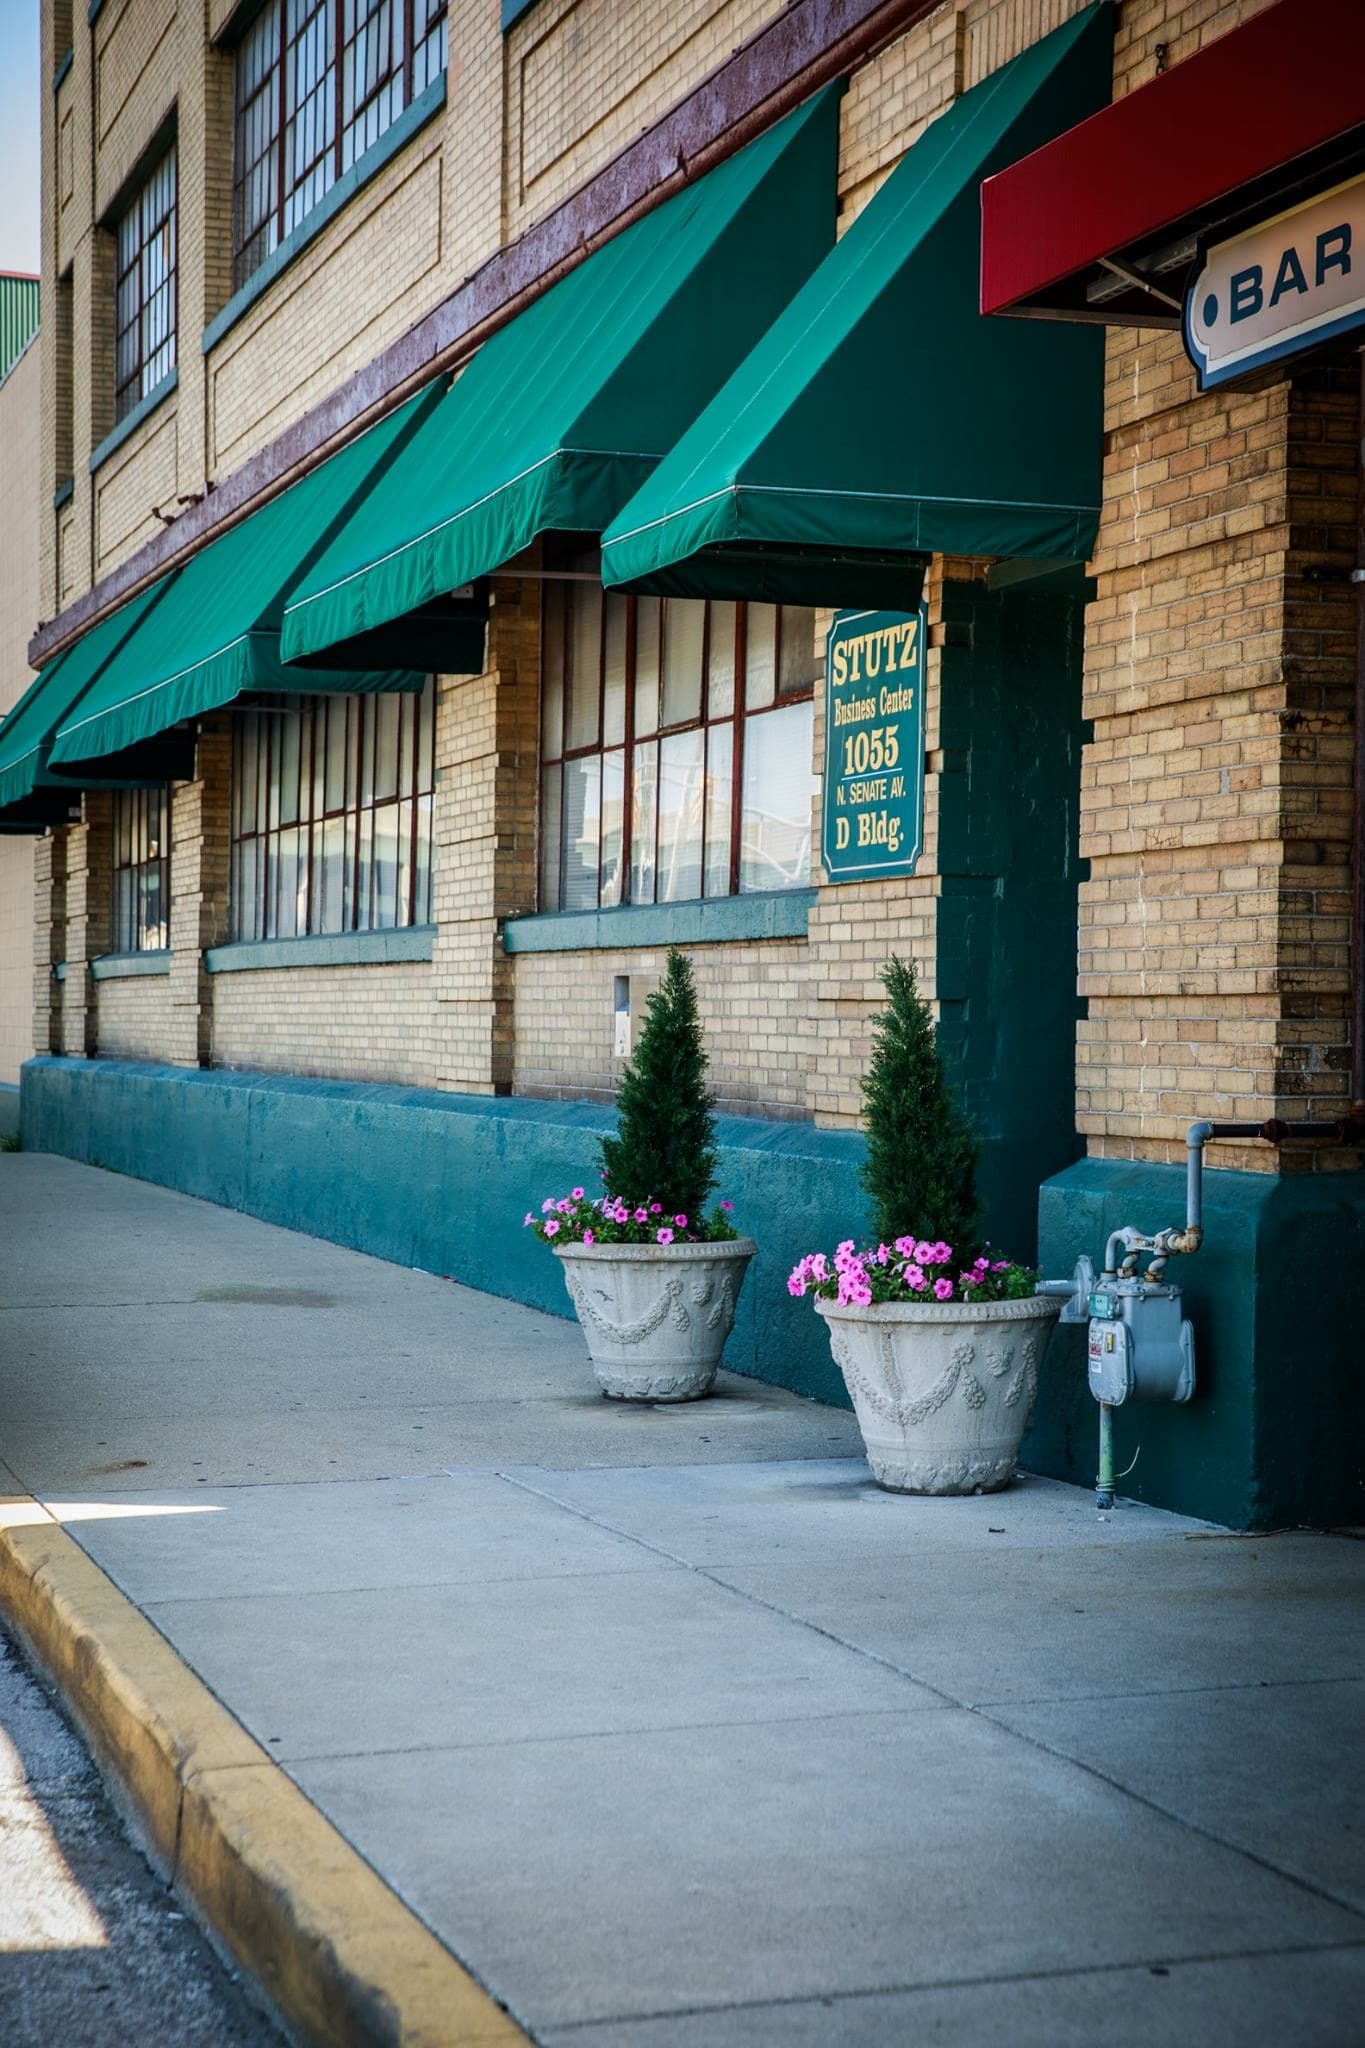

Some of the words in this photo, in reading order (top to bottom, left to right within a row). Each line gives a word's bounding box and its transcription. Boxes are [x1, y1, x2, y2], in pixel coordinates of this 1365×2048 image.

[1230, 223, 1352, 325] BAR
[832, 620, 918, 687] STUTZ
[834, 693, 876, 727] Business
[880, 684, 913, 717] Center
[844, 724, 900, 776] 1055
[837, 785, 846, 806] N.
[849, 778, 887, 805] SENATE
[890, 776, 906, 798] AV.
[836, 816, 849, 850] D
[857, 810, 904, 852] Bldg.
